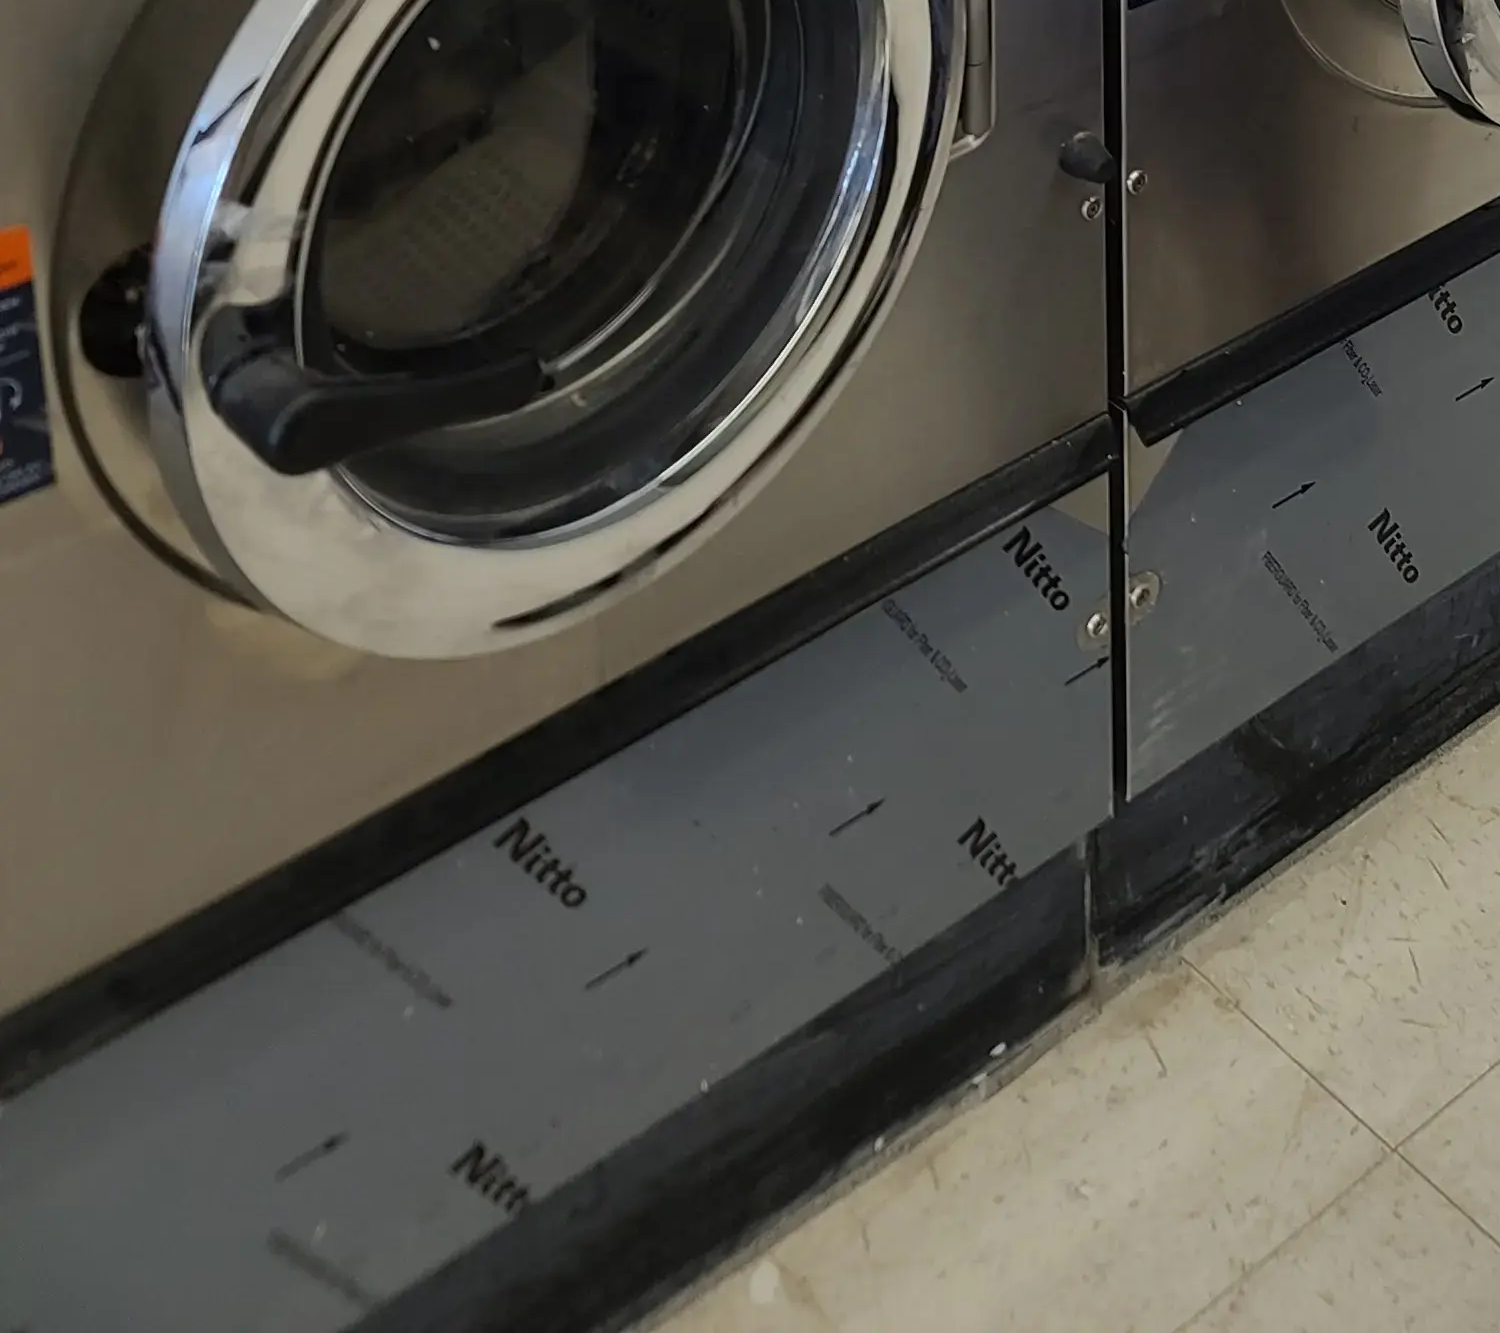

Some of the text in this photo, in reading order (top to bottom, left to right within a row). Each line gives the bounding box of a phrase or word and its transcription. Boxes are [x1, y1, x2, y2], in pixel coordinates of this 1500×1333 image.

[1002, 525, 1070, 611] Nitto
[1367, 507, 1419, 584] Nitto
[493, 816, 588, 910] Nitto
